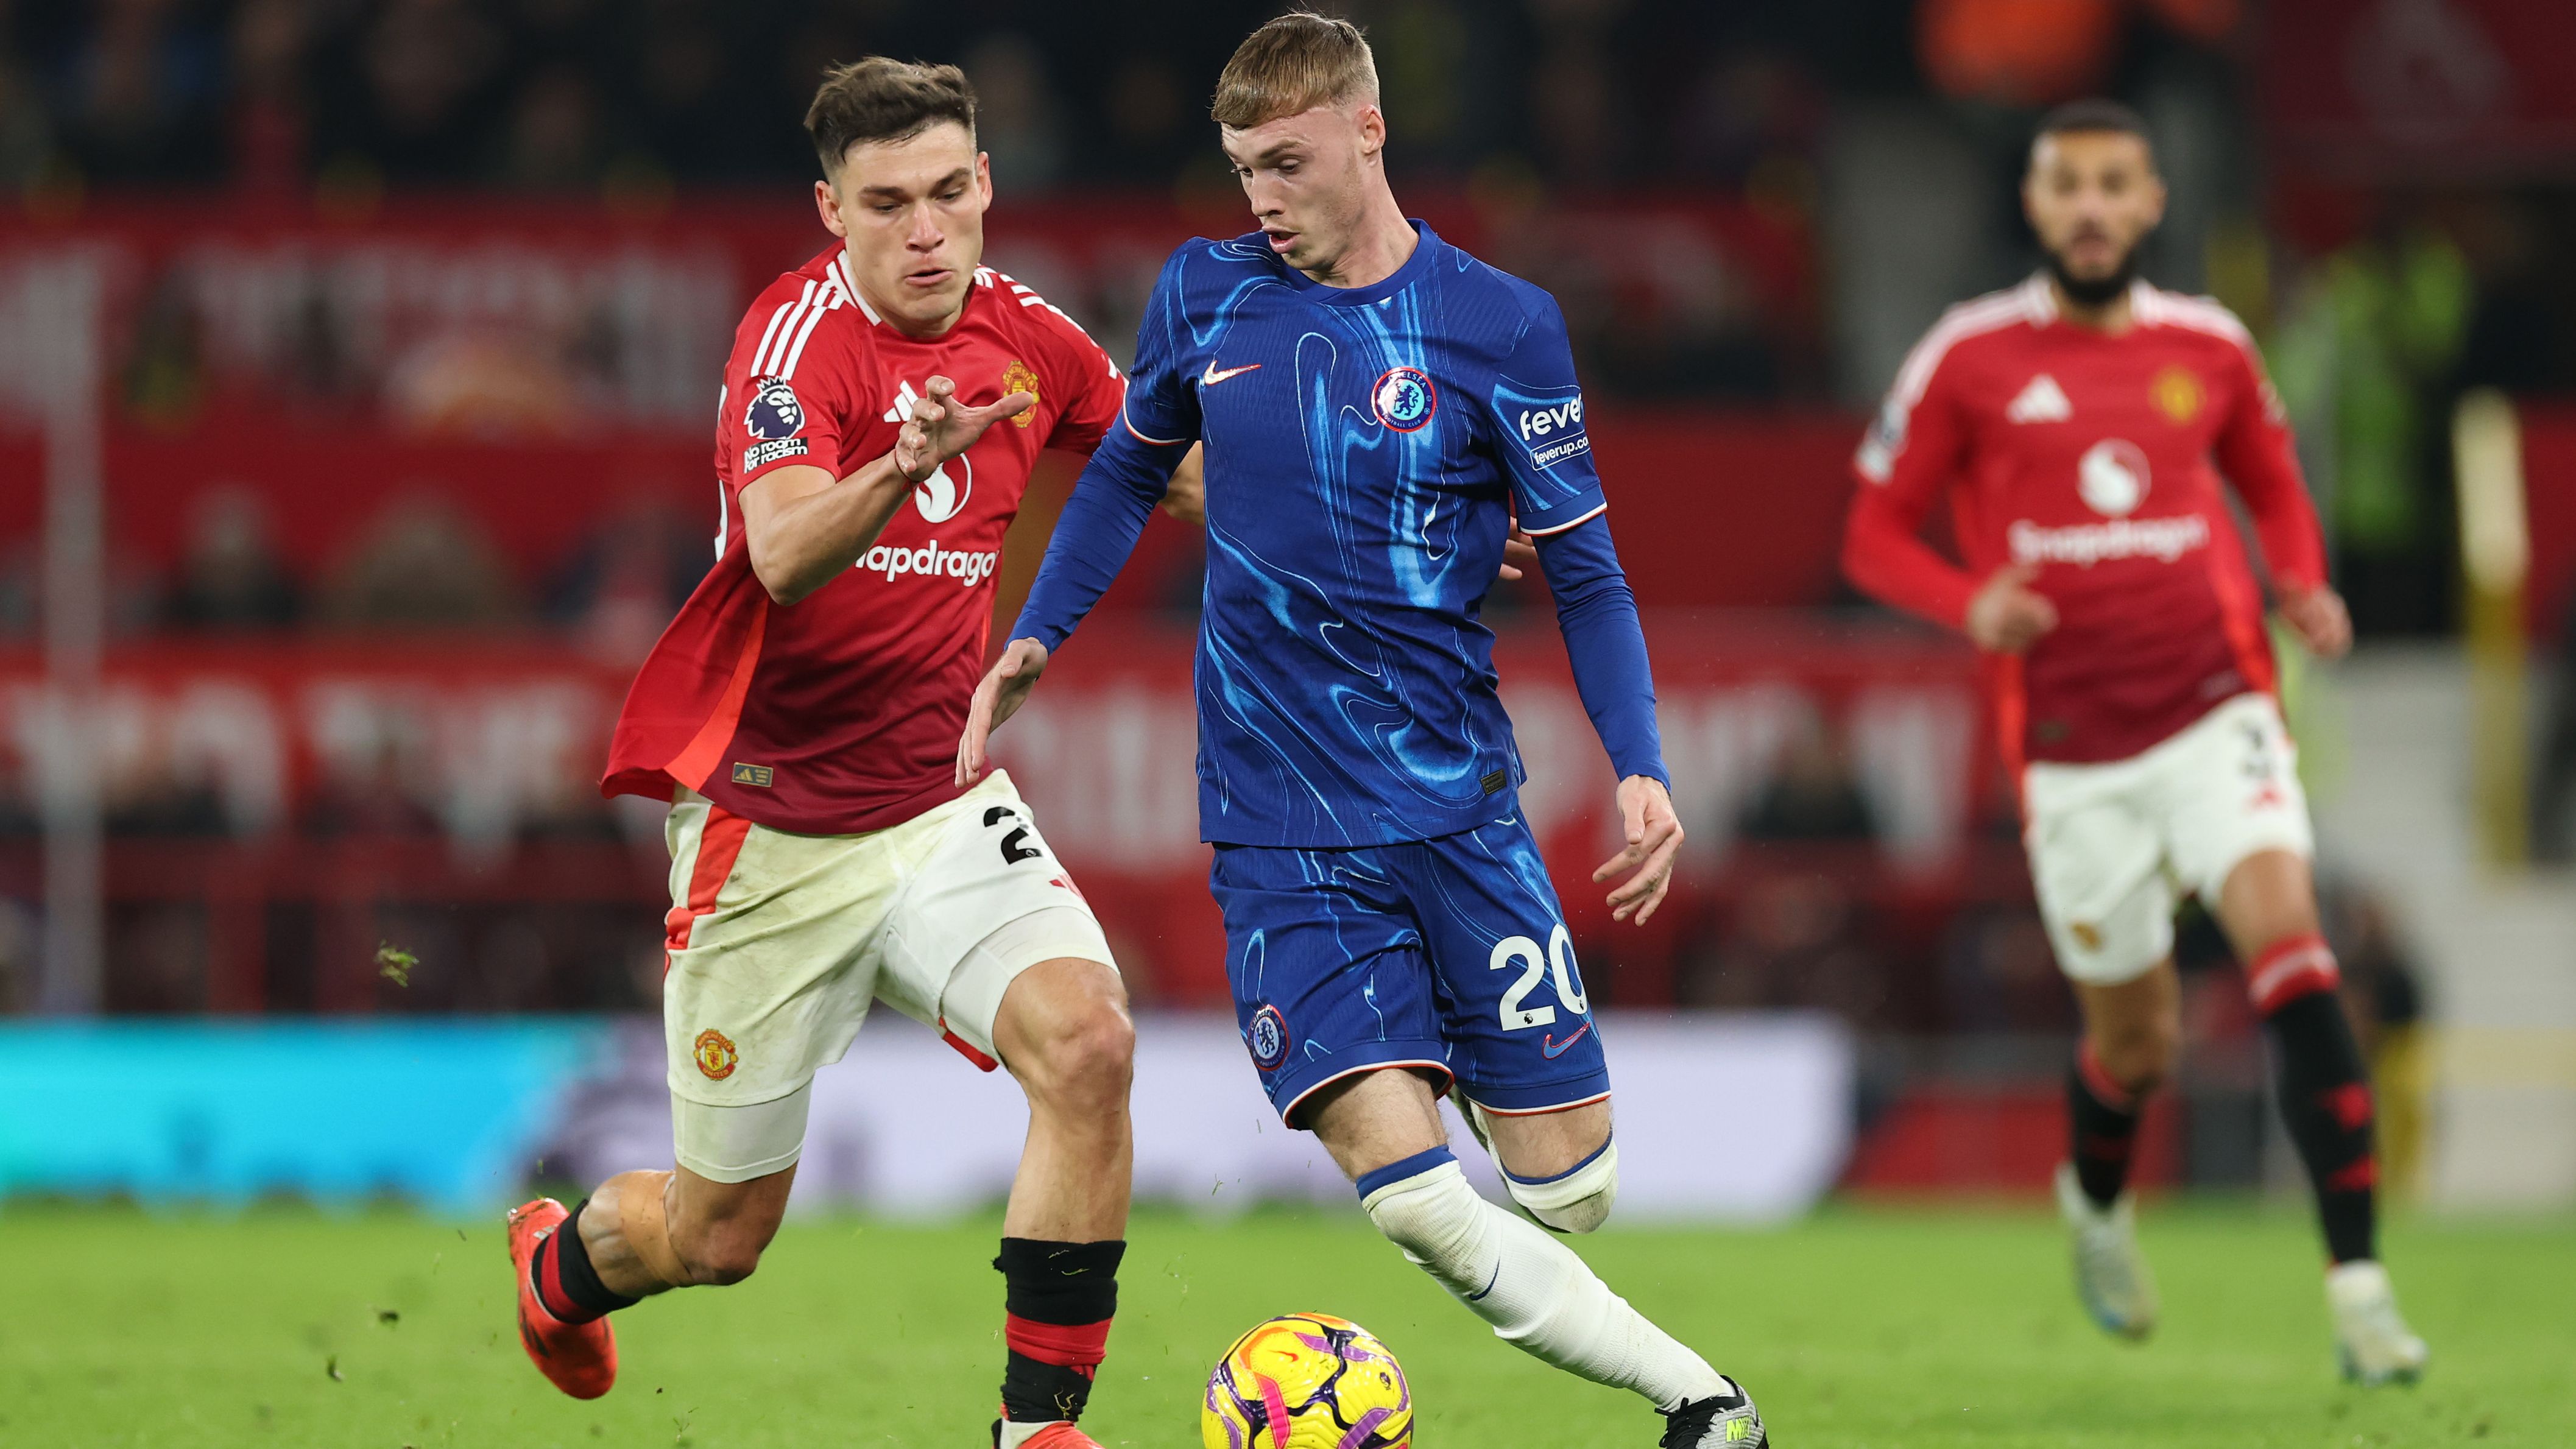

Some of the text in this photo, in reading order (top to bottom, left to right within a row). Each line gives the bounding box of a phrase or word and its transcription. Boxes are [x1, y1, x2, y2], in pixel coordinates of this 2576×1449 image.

[744, 439, 801, 460] No room
[744, 446, 808, 474] for racism
[855, 540, 999, 587] apdrago
[1490, 923, 1587, 1031] 20
